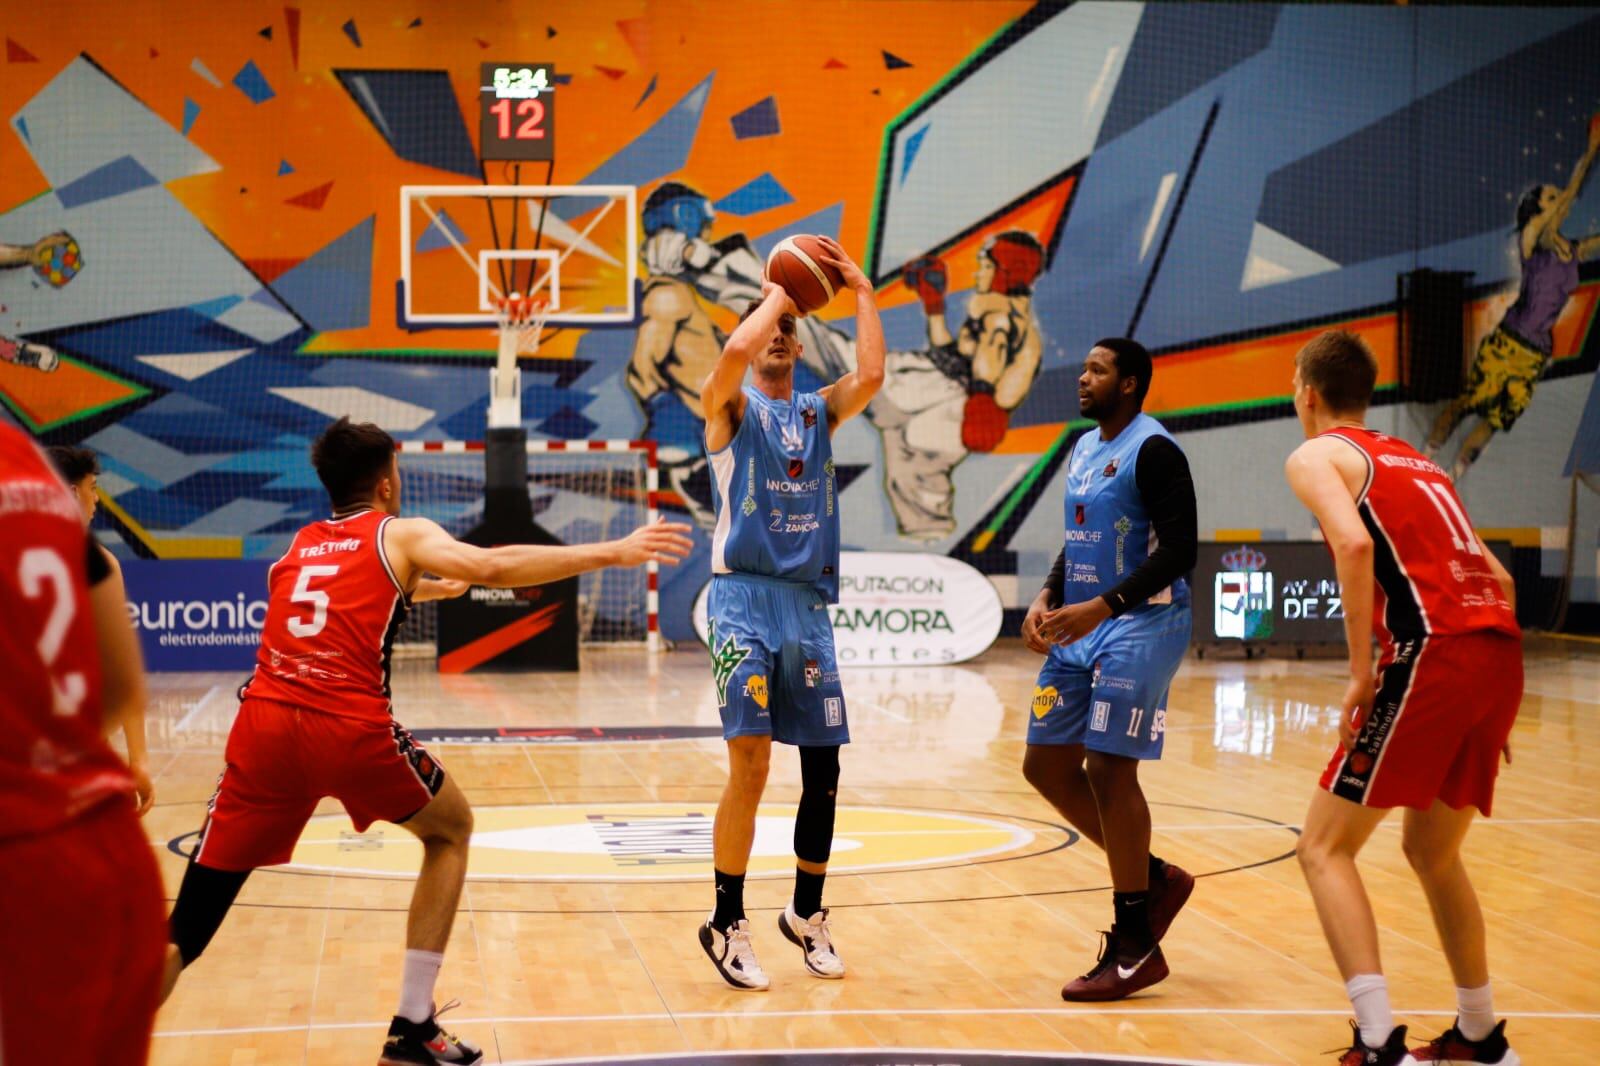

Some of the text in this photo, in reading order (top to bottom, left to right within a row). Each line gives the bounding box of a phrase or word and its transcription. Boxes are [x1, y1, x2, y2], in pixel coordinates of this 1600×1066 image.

[488, 98, 545, 139] 12
[1413, 478, 1482, 556] 11
[287, 565, 340, 638] 5
[1283, 598, 1346, 618] DE Z
[834, 608, 954, 633] AMORA
[1126, 707, 1144, 737] 11
